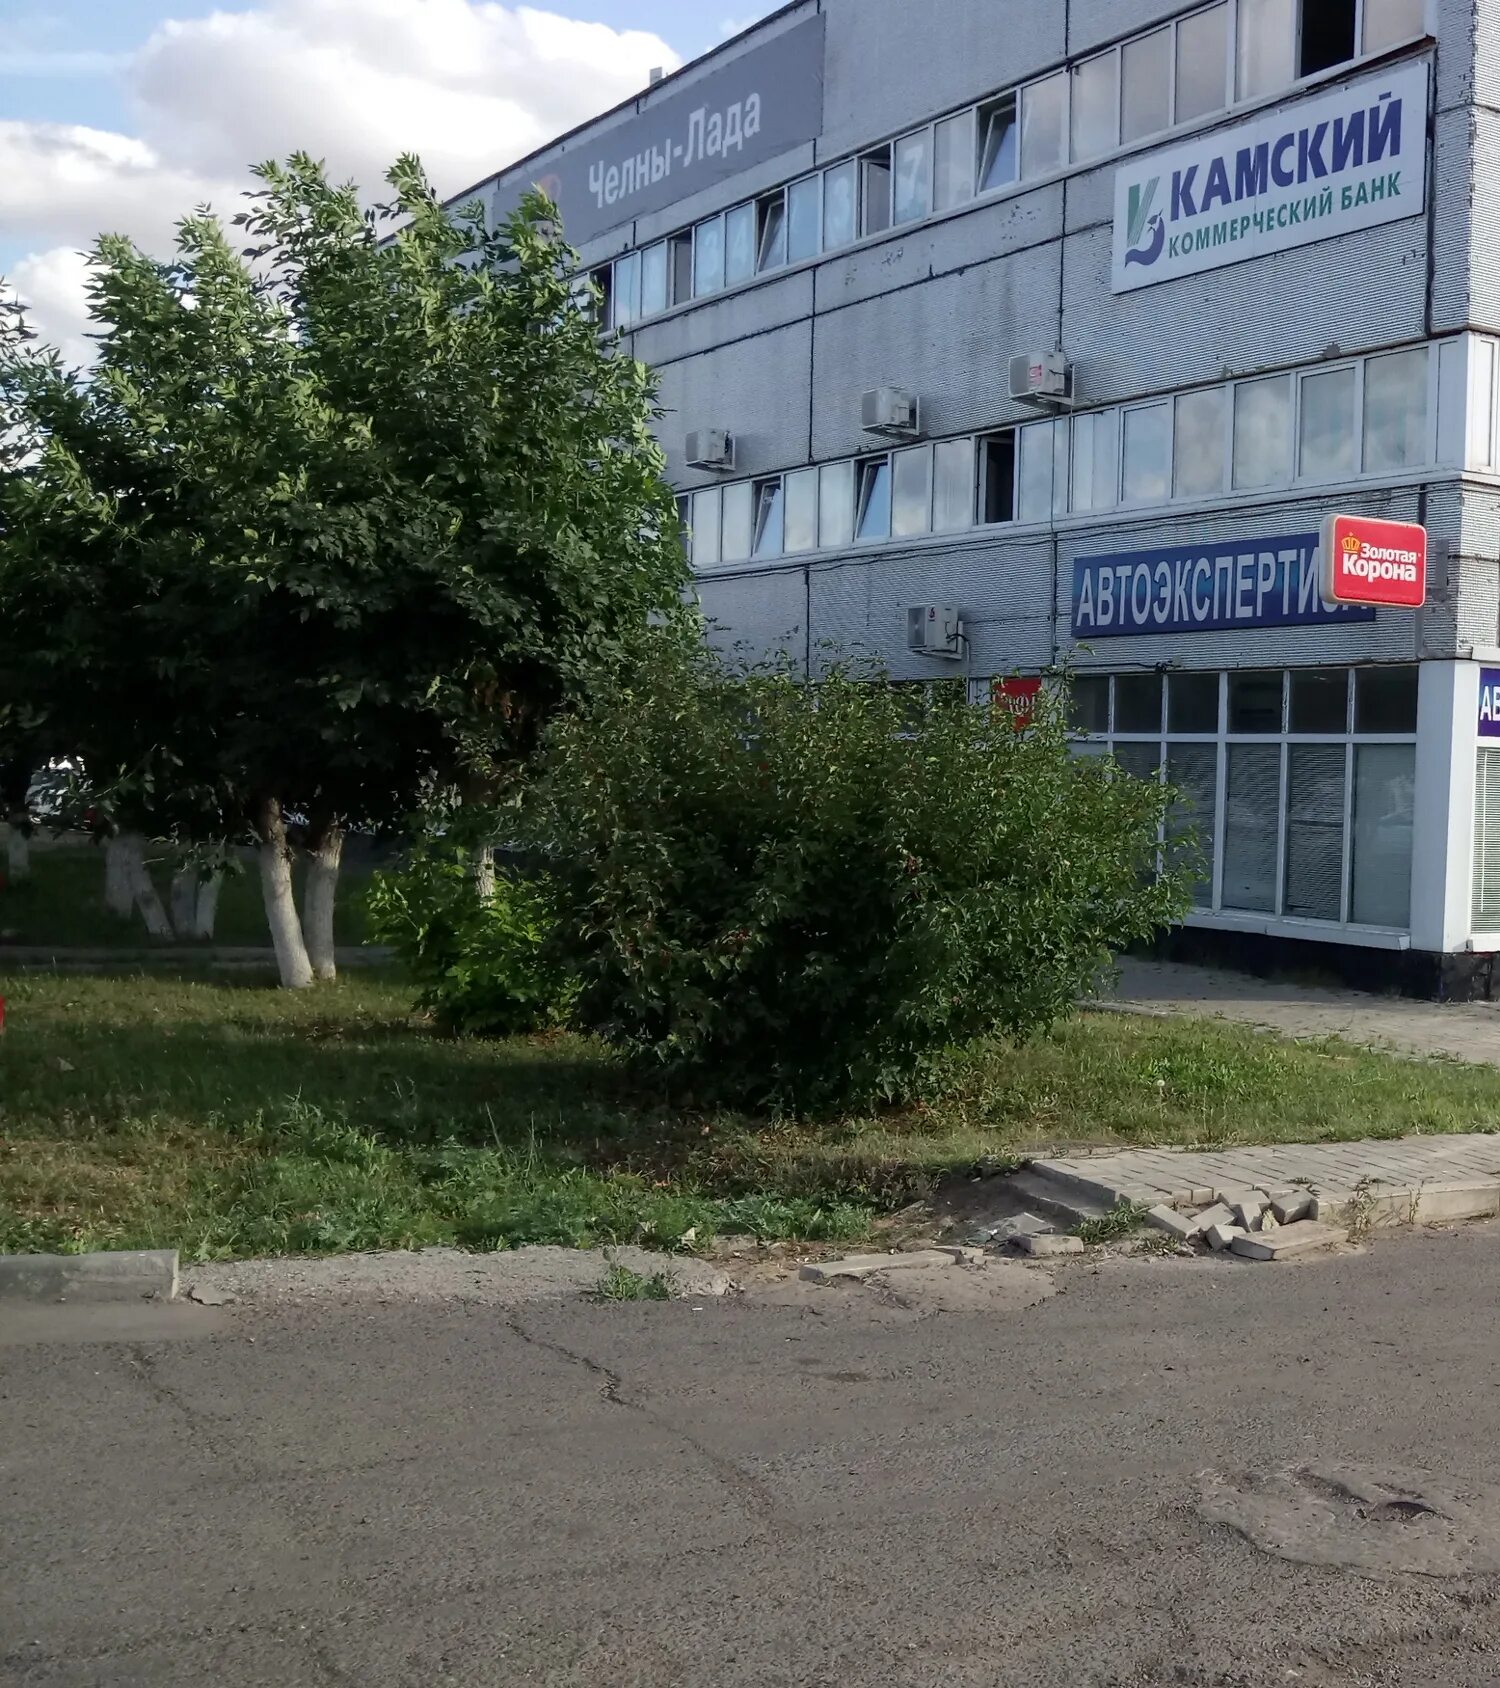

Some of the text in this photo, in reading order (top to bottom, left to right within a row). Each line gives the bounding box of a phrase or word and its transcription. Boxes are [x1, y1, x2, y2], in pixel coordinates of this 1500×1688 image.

[589, 92, 761, 209] Челны-Лада
[1170, 91, 1402, 221] КАМСКИЙ
[1168, 171, 1402, 259] КОММЕРЧЕСКИЙ БАНК
[1076, 546, 1367, 627] АВТОЭКСПЕРТИ
[1342, 553, 1417, 583] Корона
[1360, 542, 1417, 563] Золотая
